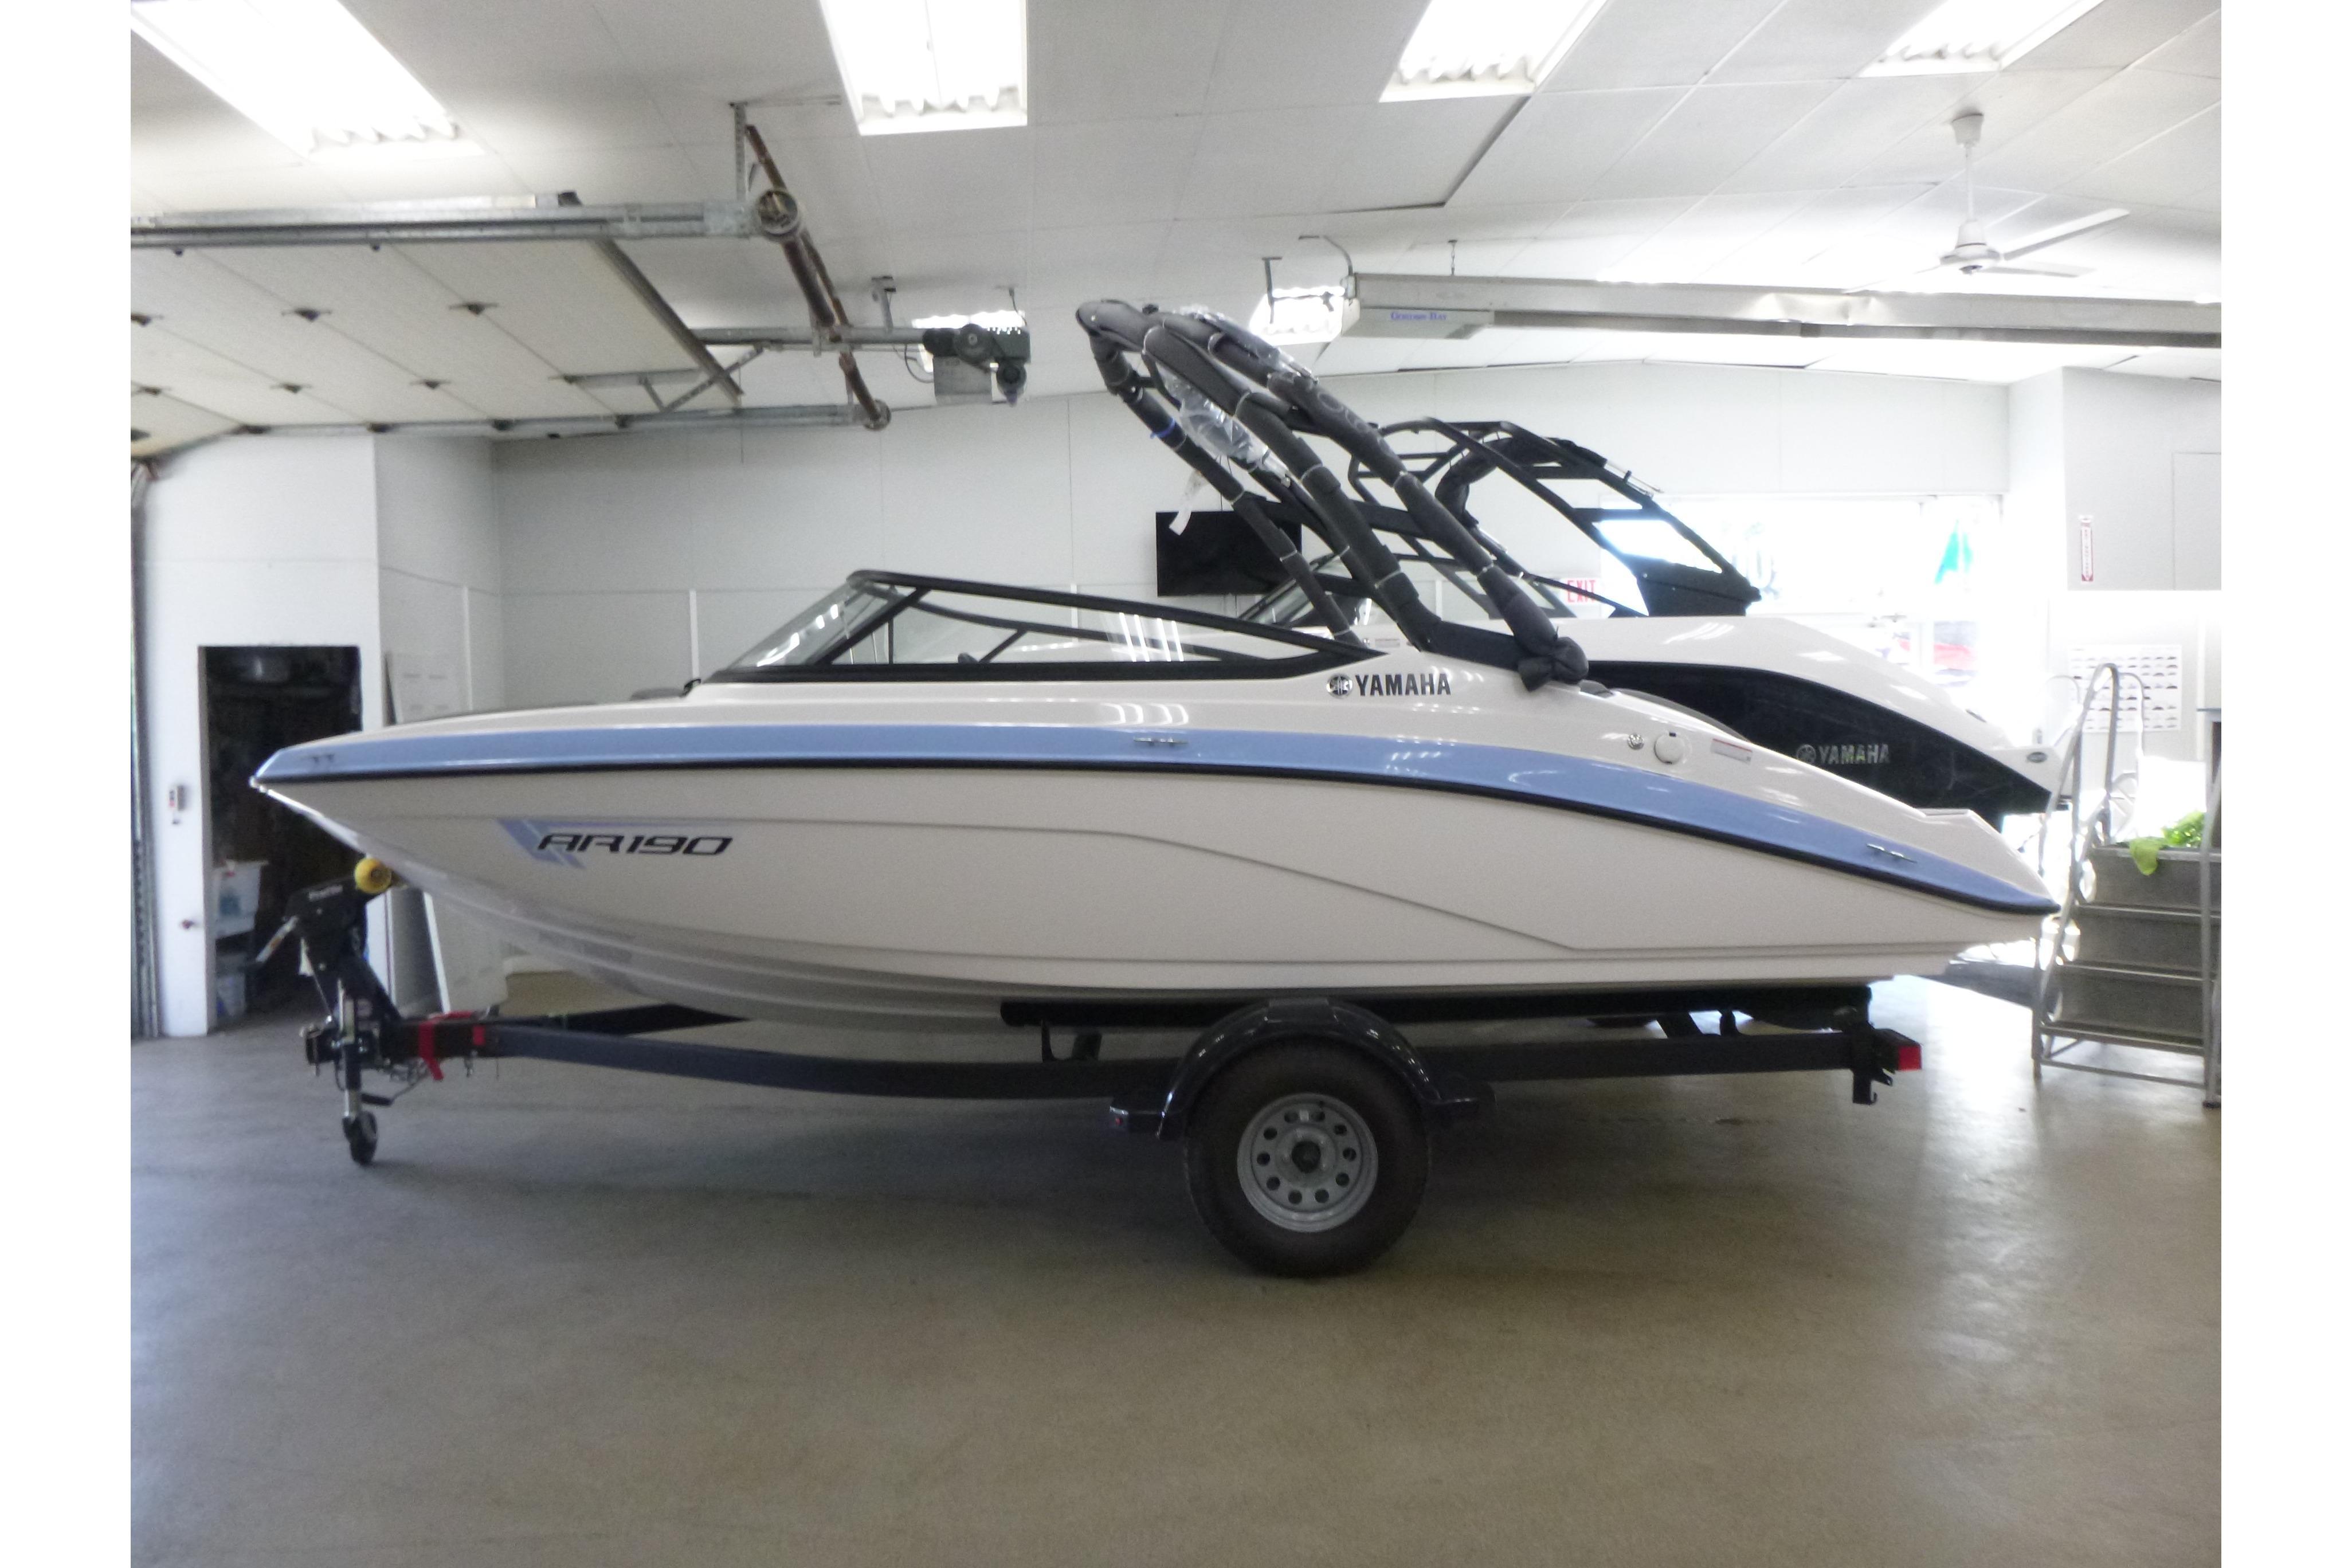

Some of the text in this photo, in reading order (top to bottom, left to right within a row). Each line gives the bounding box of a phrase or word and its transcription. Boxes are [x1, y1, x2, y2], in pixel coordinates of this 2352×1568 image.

[1567, 579, 1596, 603] EXIT
[1355, 673, 1451, 696] YAMAHA
[1818, 744, 1890, 765] YAMAHA
[538, 833, 733, 856] AR190
